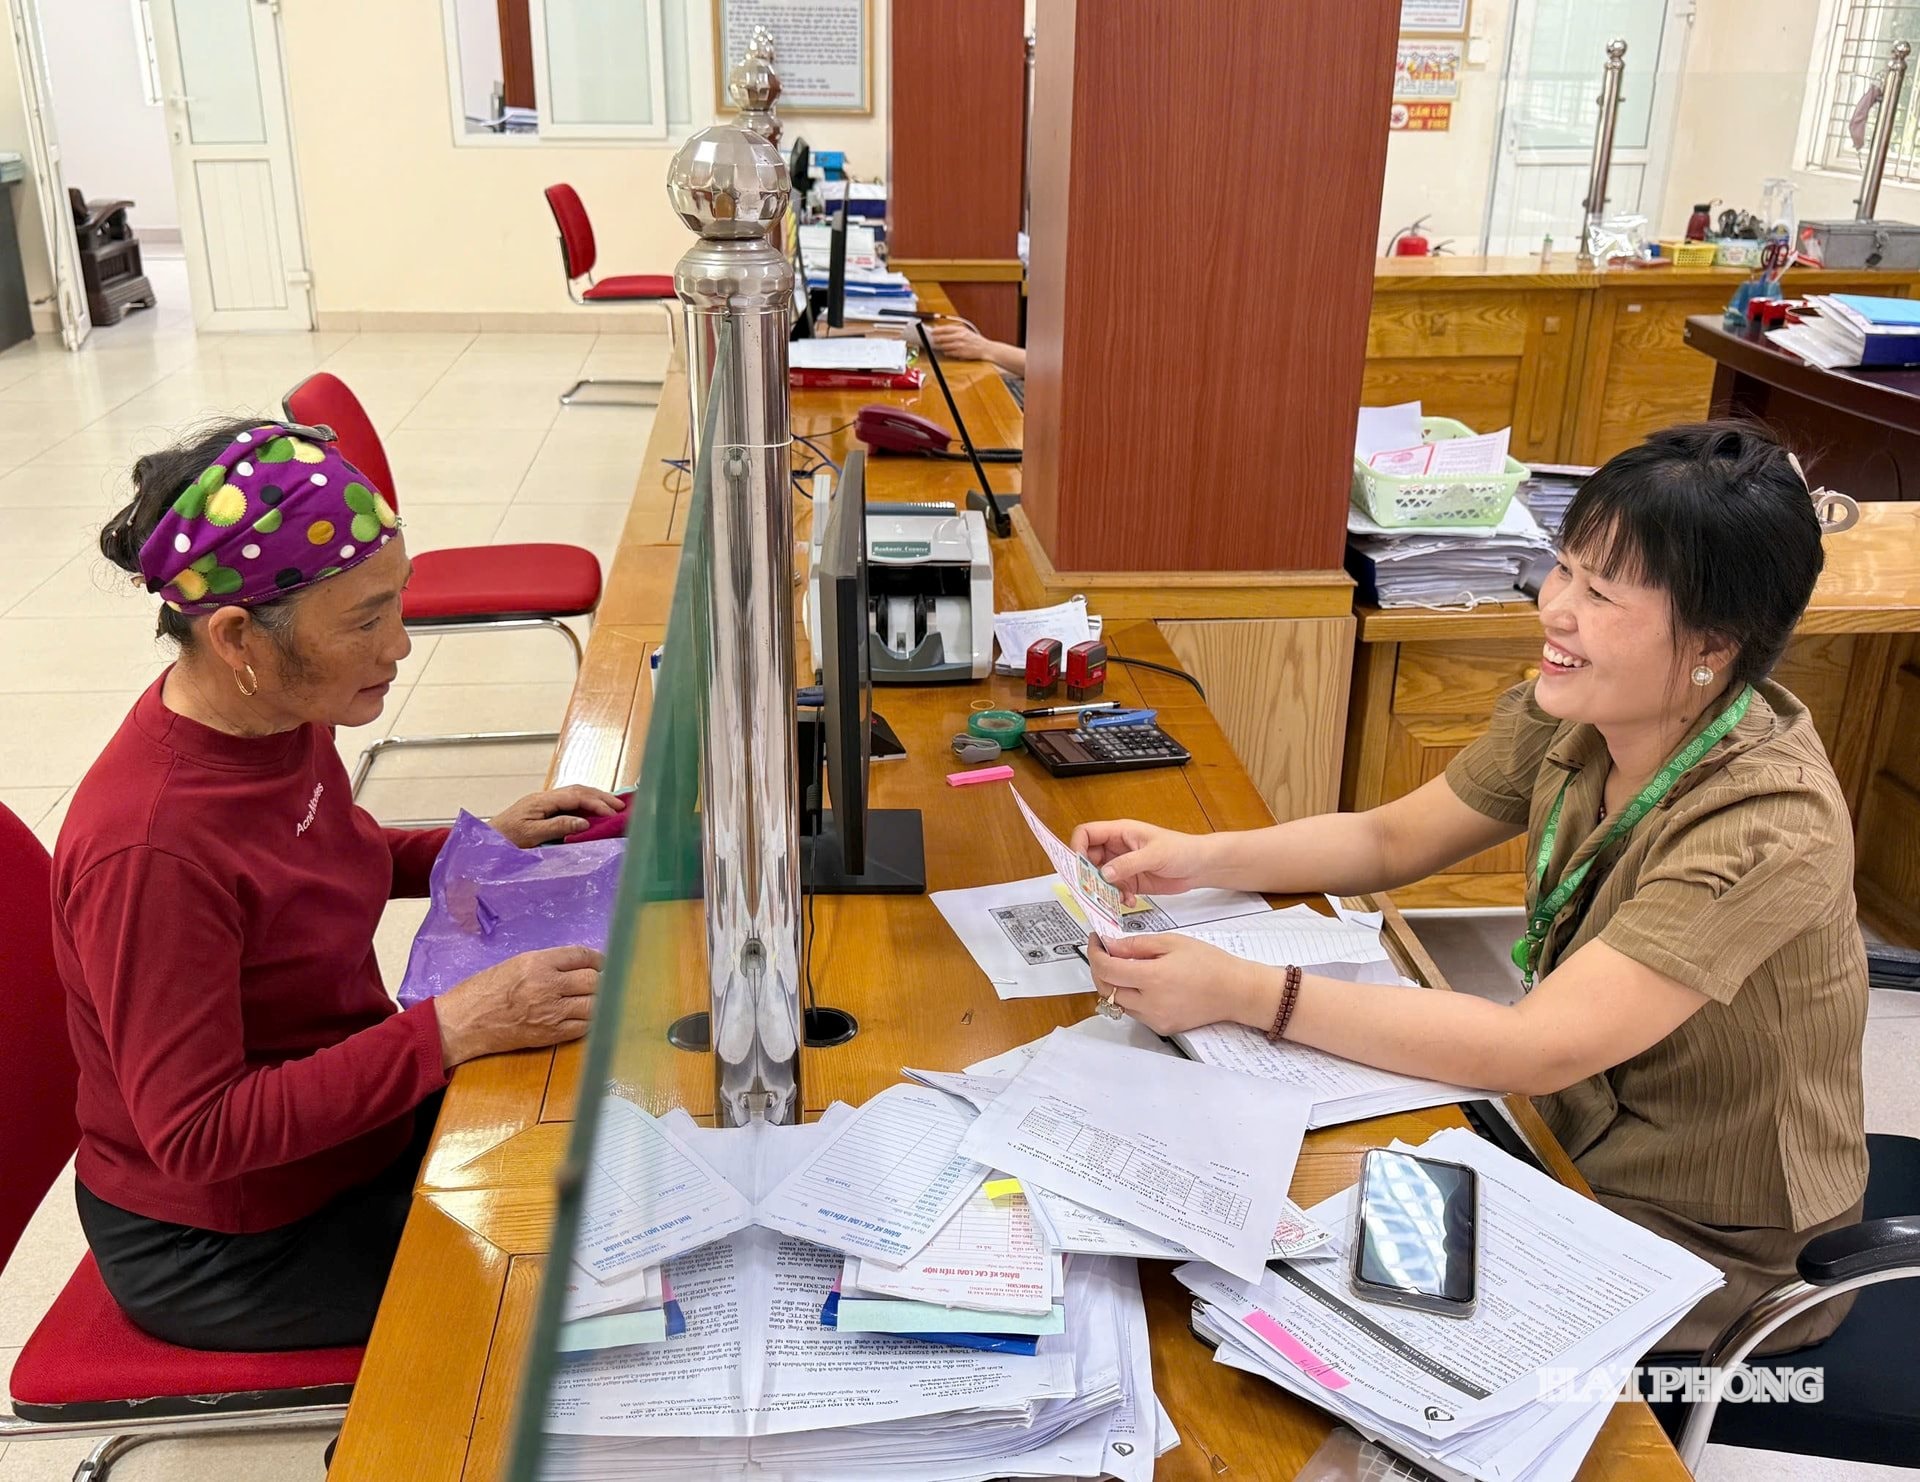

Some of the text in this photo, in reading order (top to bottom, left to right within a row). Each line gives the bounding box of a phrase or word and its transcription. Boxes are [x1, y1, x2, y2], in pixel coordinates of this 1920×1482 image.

[1670, 738, 1704, 772] VBSP
[1639, 770, 1672, 804] VBSP
[816, 1208, 902, 1238] BẢNG KÊ CÁC LOẠI TIỀN LĨNH
[922, 1266, 937, 1274] NỘP
[939, 1267, 955, 1275] TIỀN
[956, 1268, 973, 1276] LOẠI
[974, 1269, 988, 1277] CÁC
[999, 1270, 1019, 1278] BẢNG
